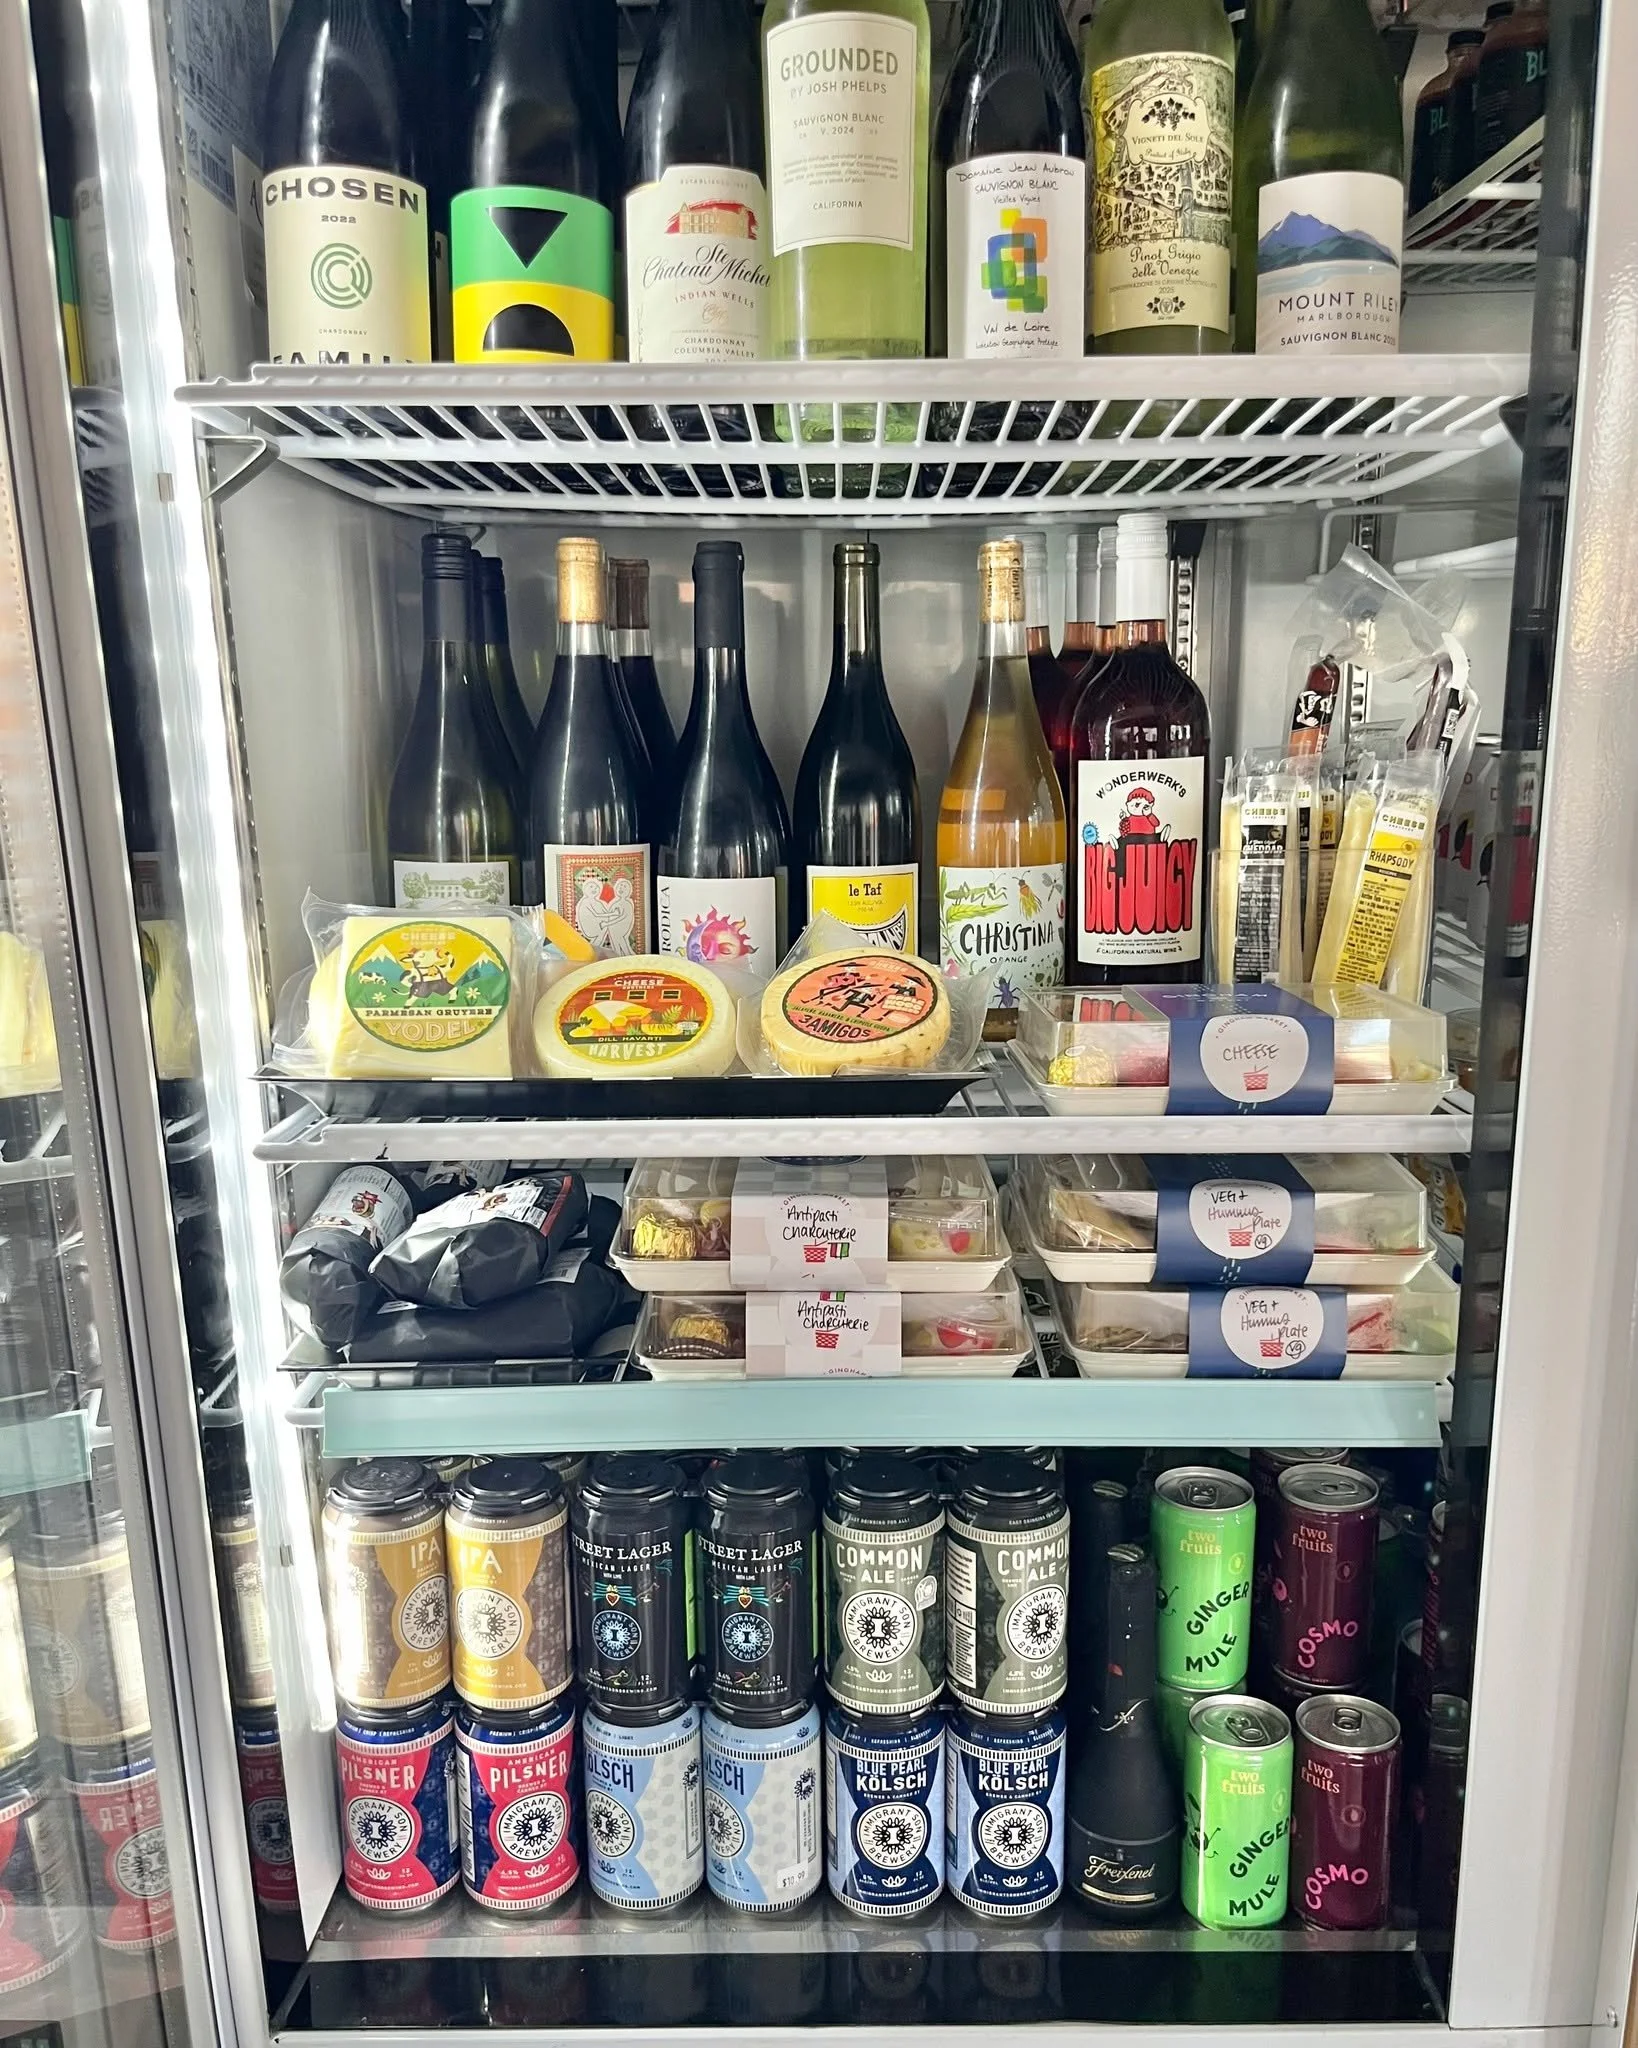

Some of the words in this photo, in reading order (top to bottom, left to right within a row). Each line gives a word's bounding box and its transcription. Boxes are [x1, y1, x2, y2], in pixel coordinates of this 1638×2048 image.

[781, 48, 898, 81] GROUNDED
[808, 82, 837, 95] JOSH
[842, 80, 887, 94] PHELPS
[793, 114, 848, 128] SAUVIGNON
[852, 113, 885, 124] BLANC
[832, 126, 854, 135] 2024
[956, 166, 1003, 183] Domaine
[265, 176, 420, 215] CHOSEN
[975, 180, 1024, 194] SAUVIGNON
[1029, 180, 1059, 190] BLANC
[813, 201, 863, 210] CALIFORNIA
[321, 214, 357, 224] 2022
[1130, 246, 1162, 262] Pinot
[1168, 243, 1201, 261] Grigio
[643, 256, 712, 288] Chateau
[1132, 261, 1157, 277] delle
[1157, 260, 1200, 281] Venezie
[675, 290, 716, 303] INDIAN
[722, 291, 754, 309] WELLS
[1278, 292, 1355, 313] MOUNT
[984, 323, 998, 334] Val
[1004, 323, 1018, 332] de
[1024, 321, 1051, 332] Loire
[1297, 312, 1390, 323] MARLBOROUGH
[684, 337, 746, 347] CHARDONNAY
[1280, 332, 1347, 346] SAUVIGNON
[1351, 332, 1381, 343] BLANC
[725, 348, 754, 358] VALLEY
[1095, 771, 1187, 799] WONDERWERK'S
[1382, 814, 1425, 829] CHEESE
[1369, 850, 1415, 869] RHAPSODY
[849, 884, 859, 896] le
[863, 883, 882, 896] Taf
[1084, 841, 1117, 934] BIG
[1118, 838, 1197, 935] JUICY
[660, 885, 671, 952] RODICA
[960, 920, 1053, 955] CHRISTINA
[365, 1009, 432, 1017] PARMESAN
[437, 1008, 493, 1016] GRUYERE
[386, 1019, 476, 1042] YODEL
[588, 1043, 667, 1060] HARVEST
[1223, 1044, 1280, 1061] CHEESE
[1211, 1190, 1236, 1204] VEG
[787, 1205, 838, 1222] Antipasti
[797, 1301, 847, 1318] Antipasti
[1245, 1300, 1268, 1314] VEG
[1188, 1529, 1216, 1542] two
[1300, 1524, 1327, 1540] two
[410, 1536, 441, 1568] IPA
[617, 1541, 672, 1560] LAGER
[751, 1540, 803, 1561] LAGER
[1180, 1540, 1222, 1556] fruits
[1292, 1533, 1334, 1554] fruits
[582, 1557, 615, 1571] MEXICAN
[621, 1563, 650, 1572] LAGER
[712, 1560, 748, 1573] MEXICAN
[754, 1563, 783, 1573] LAGER
[836, 1543, 922, 1572] COMMON
[860, 1569, 895, 1584] ALE
[1027, 1561, 1057, 1583] ALE
[504, 1605, 517, 1626] SON
[848, 1597, 897, 1626] IMMIGRANT
[899, 1606, 911, 1629] SON
[1011, 1591, 1057, 1631] IMMIGRANT
[1187, 1581, 1250, 1635] GINGER
[594, 1613, 628, 1633] IMMIGRANT
[628, 1621, 638, 1639] SON
[724, 1616, 760, 1638] IMMIGRANT
[761, 1620, 770, 1639] SON
[599, 1643, 635, 1658] BREWERY
[728, 1645, 766, 1659] BREWERY
[853, 1639, 905, 1659] BREWERY
[1016, 1631, 1061, 1656] BREWERY
[1185, 1633, 1237, 1673] MULE
[1298, 1619, 1358, 1669] COSMO
[352, 1755, 397, 1765] AMERICAN
[508, 1749, 555, 1765] AMERICAN
[857, 1760, 886, 1776] BLUE
[891, 1756, 927, 1776] PEARL
[979, 1759, 1008, 1776] BLUE
[1014, 1756, 1048, 1775] PEARL
[341, 1756, 416, 1790] PILSNER
[490, 1750, 567, 1793] PILSNER
[1231, 1769, 1259, 1782] two
[1308, 1759, 1334, 1779] two
[857, 1770, 927, 1791] KÖLSCH
[978, 1771, 1049, 1791] KÖLSCH
[1222, 1780, 1265, 1795] fruits
[1301, 1766, 1340, 1794] fruits
[351, 1802, 393, 1826] IMMIGRANT
[394, 1810, 408, 1832] SON
[503, 1797, 551, 1833] IMMIGRANT
[552, 1801, 562, 1821] SON
[619, 1813, 631, 1834] SON
[731, 1814, 741, 1835] SON
[864, 1807, 911, 1836] IMMIGRANT
[911, 1813, 922, 1833] SON
[984, 1808, 1032, 1836] IMMIGRANT
[1033, 1814, 1043, 1833] SON
[355, 1837, 402, 1858] BREWERY
[510, 1831, 559, 1857] BREWERY
[869, 1844, 917, 1864] BREWERY
[990, 1844, 1038, 1864] BREWERY
[783, 1870, 805, 1888] $10.99
[1084, 1855, 1156, 1884] Freixenet
[1229, 1873, 1280, 1917] MULE
[1305, 1863, 1368, 1910] COSMO
